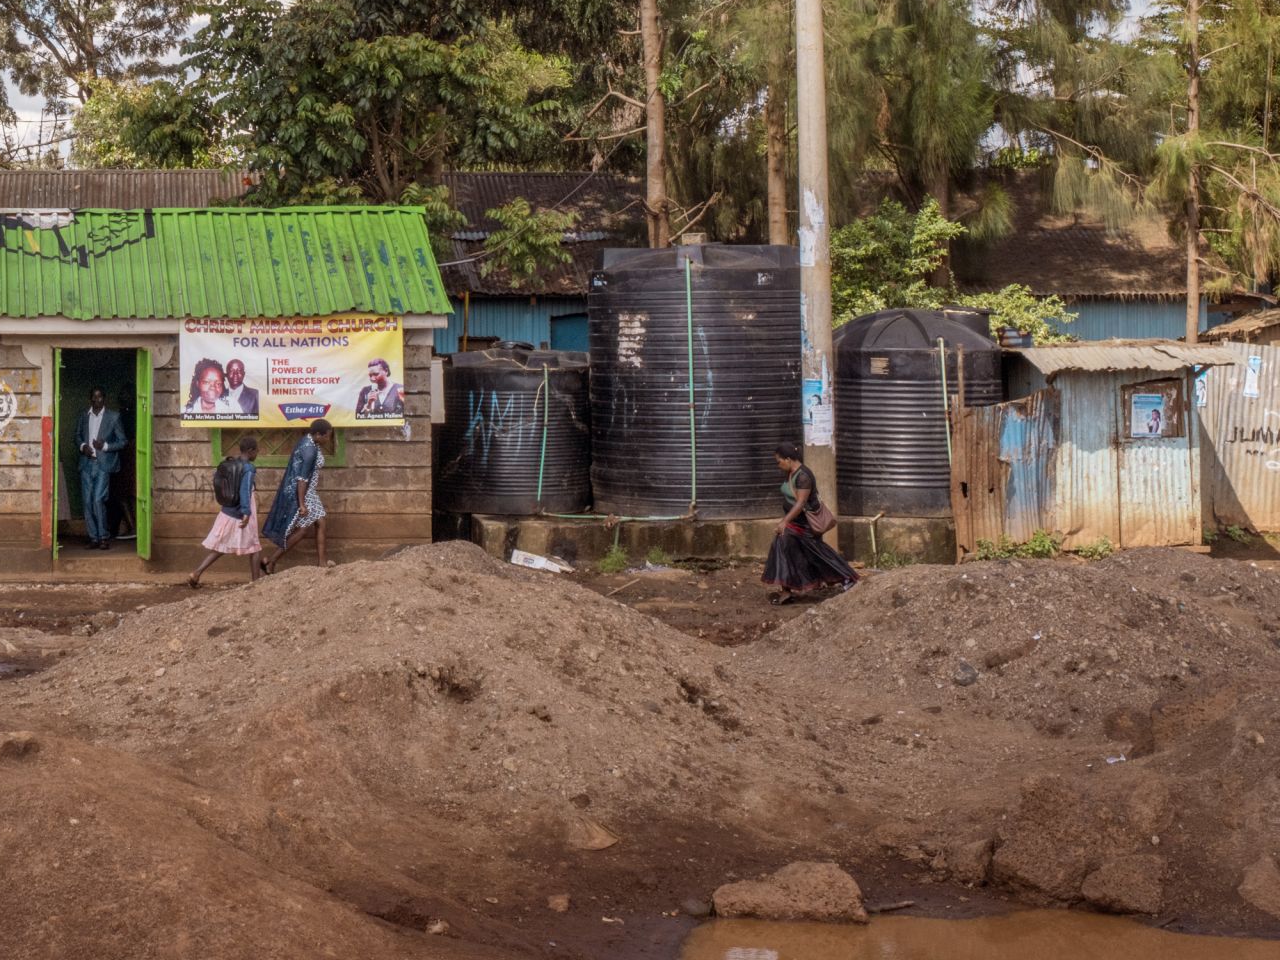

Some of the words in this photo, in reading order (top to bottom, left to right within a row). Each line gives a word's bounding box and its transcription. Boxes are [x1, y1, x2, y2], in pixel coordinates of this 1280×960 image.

[185, 318, 245, 333] CHRIST
[250, 319, 322, 334] MIRACLE
[327, 317, 398, 333] CHURCH
[233, 337, 259, 348] FOR
[263, 337, 286, 347] ALL
[290, 336, 349, 348] NATIONS
[271, 358, 289, 366] THE
[271, 366, 304, 374] POWER
[306, 366, 318, 374] OF
[271, 387, 316, 395] MINISTRY
[285, 406, 307, 414] Esther
[308, 406, 325, 414] 4:16
[1225, 426, 1280, 446] JUM
